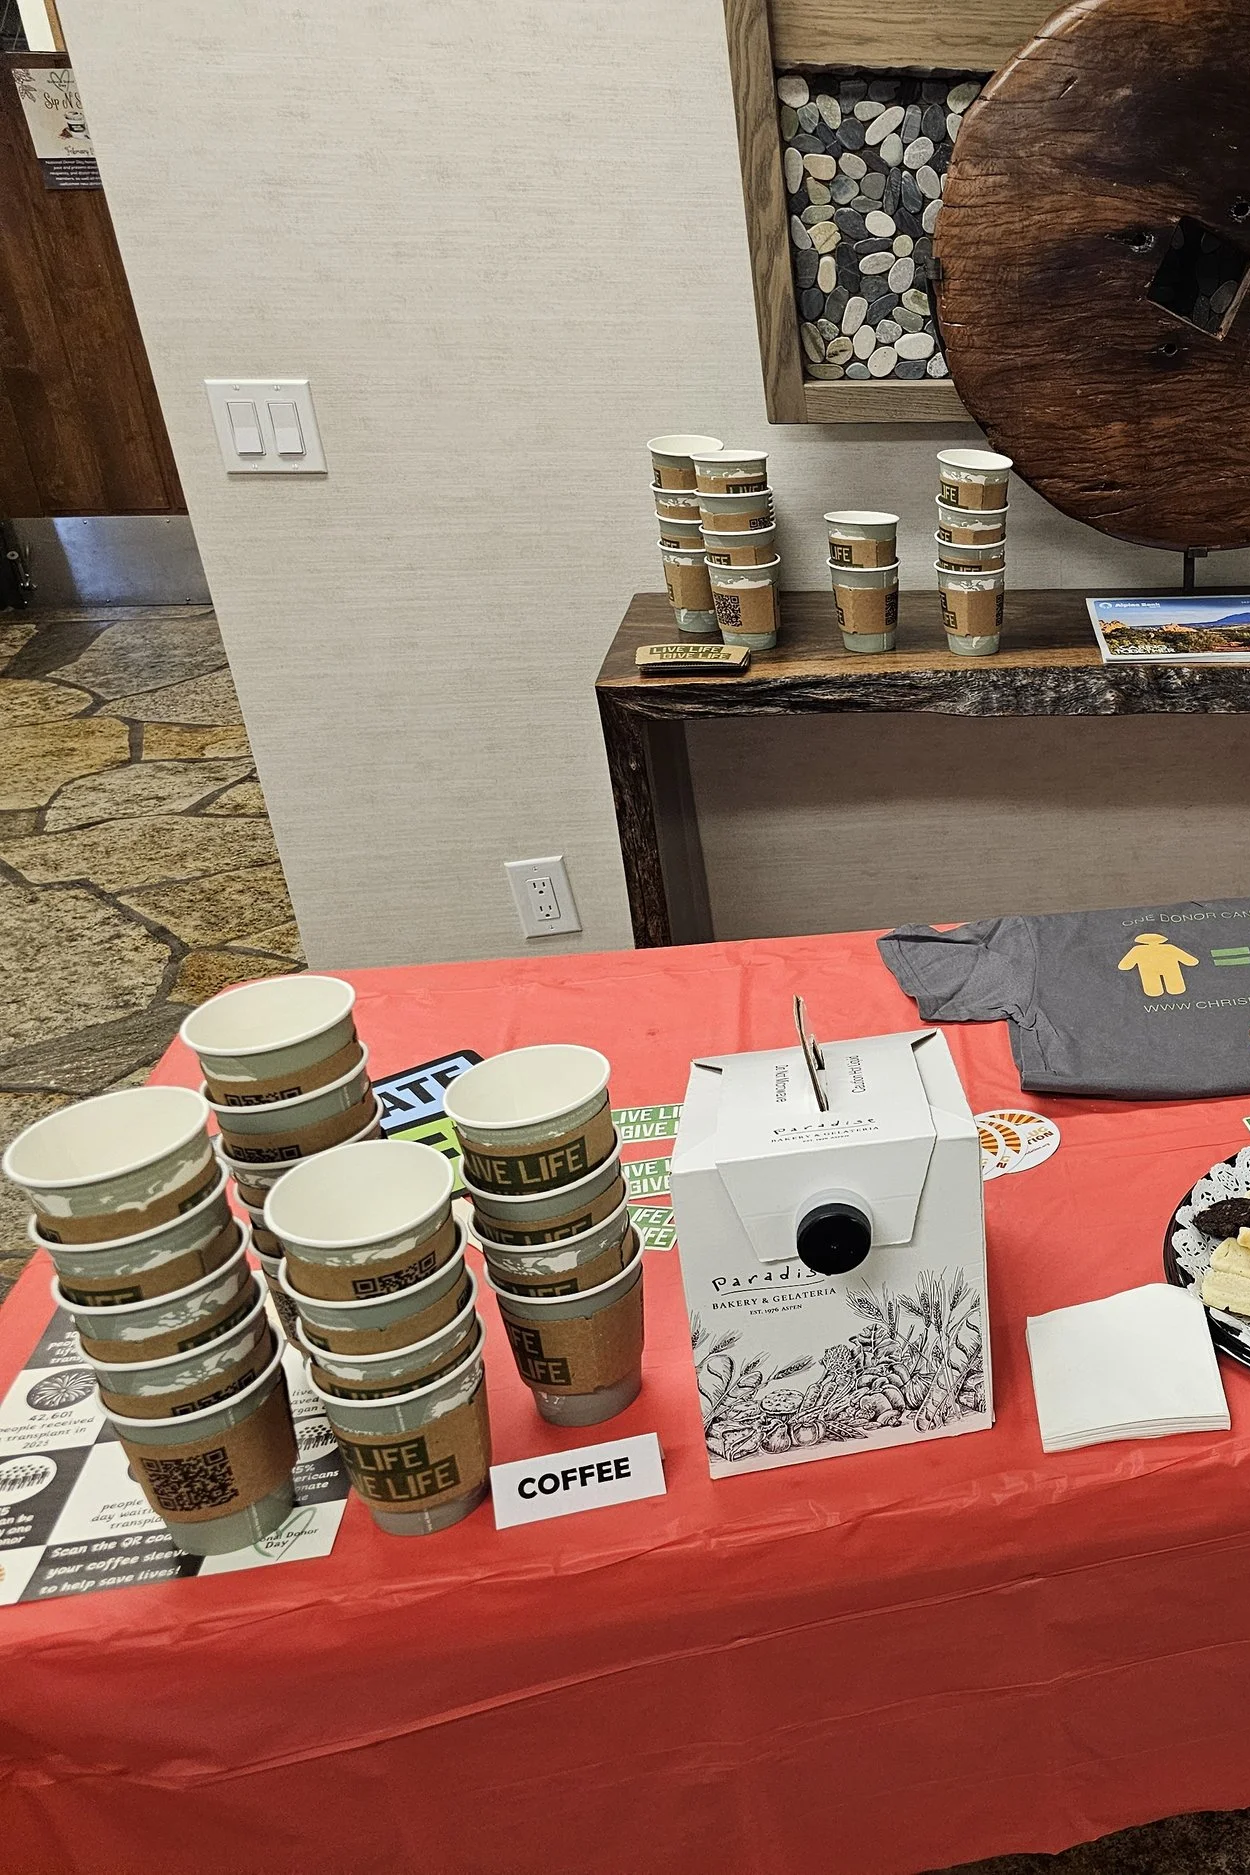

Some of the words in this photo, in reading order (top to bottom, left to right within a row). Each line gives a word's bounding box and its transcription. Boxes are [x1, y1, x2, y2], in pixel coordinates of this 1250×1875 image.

[44, 92, 59, 110] Sip
[1159, 911, 1218, 924] DONOR
[378, 1065, 462, 1118] ATE
[621, 1122, 668, 1139] GIVE
[518, 1144, 584, 1184] LIFE
[623, 1161, 658, 1179] IVE
[632, 1208, 669, 1224] IFE
[712, 1266, 818, 1292] Paradis
[712, 1298, 759, 1310] BAKERY
[772, 1288, 837, 1302] GELATERIA
[520, 1356, 566, 1384] LIFE
[28, 1410, 74, 1422] 42,601
[40, 1416, 95, 1429] received
[6, 1429, 71, 1442] transplant
[354, 1443, 423, 1472] LIFE
[386, 1462, 454, 1500] LIFE
[518, 1456, 632, 1500] COFFEE
[100, 1499, 144, 1512] people
[16, 1514, 34, 1524] be
[92, 1513, 115, 1523] day
[6, 1524, 33, 1535] one
[286, 1528, 320, 1539] Donor
[51, 1545, 88, 1558] Scan
[92, 1540, 118, 1551] the
[122, 1534, 142, 1547] QR
[264, 1538, 290, 1550] Day
[44, 1563, 84, 1580] your
[85, 1555, 140, 1572] coffee
[39, 1586, 58, 1596] to
[60, 1579, 96, 1592] help
[99, 1575, 135, 1586] save
[137, 1566, 182, 1581] lives!
